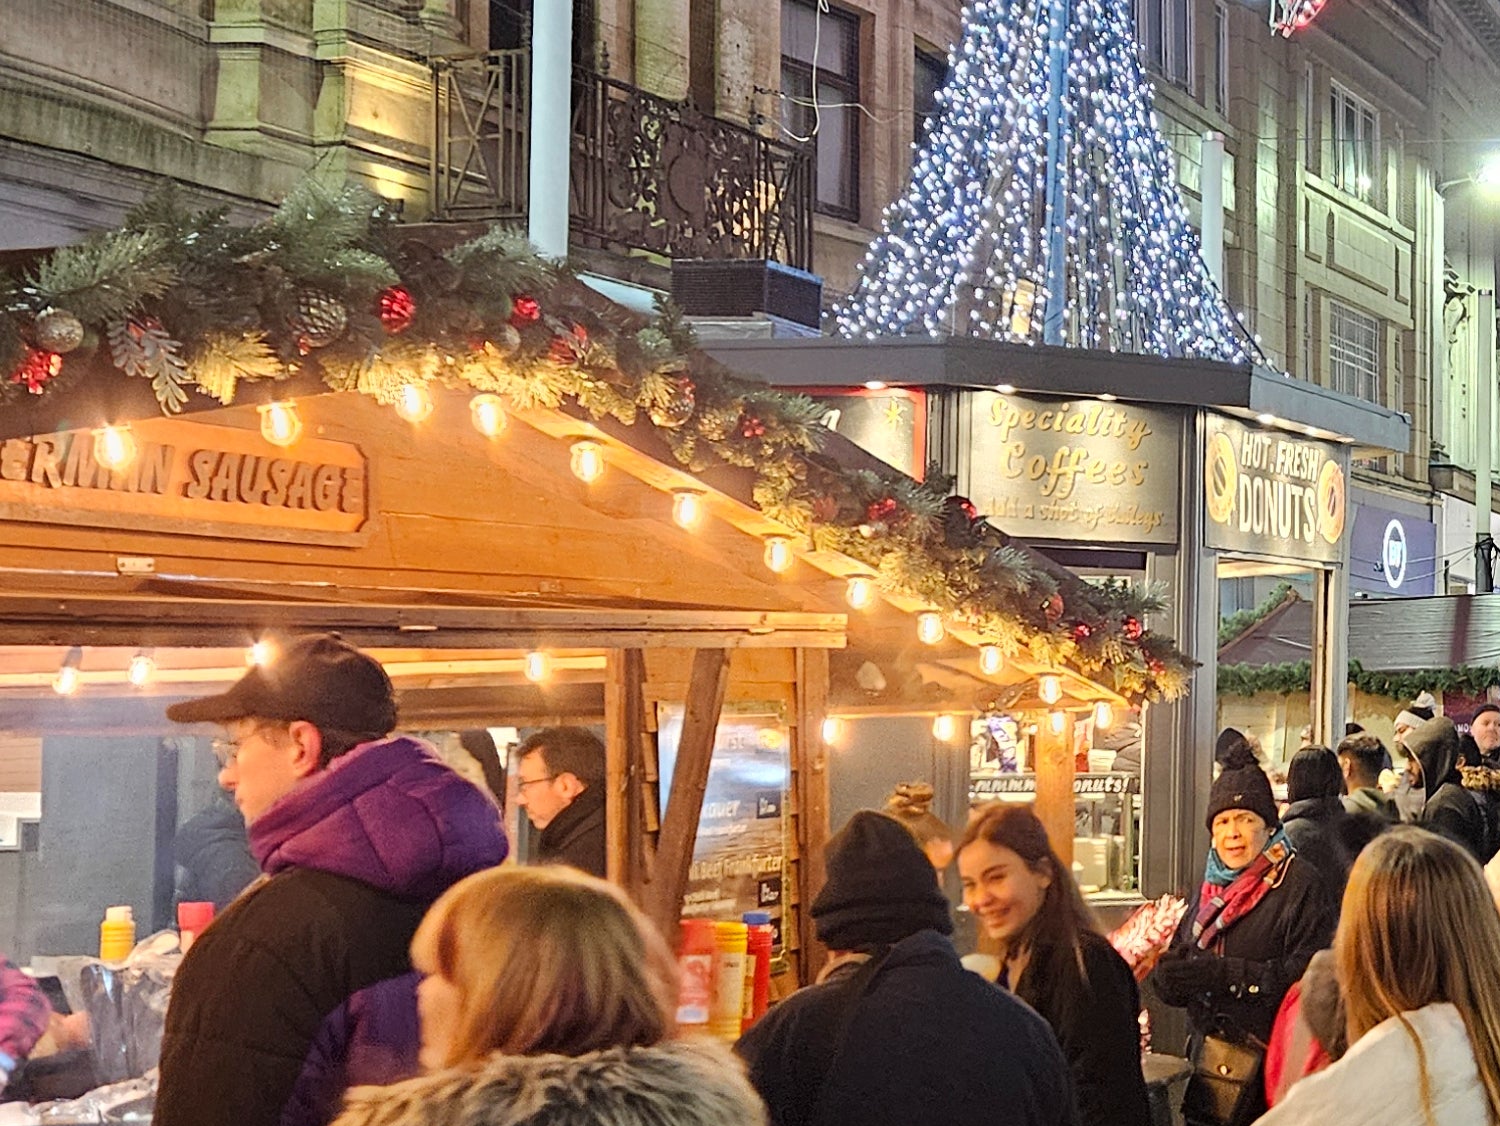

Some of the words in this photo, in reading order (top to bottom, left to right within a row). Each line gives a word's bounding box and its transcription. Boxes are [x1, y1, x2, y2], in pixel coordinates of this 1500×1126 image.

[988, 396, 1153, 450] Speciality
[182, 449, 366, 513] SAUSAGE
[1002, 446, 1150, 499] Coffees
[1275, 440, 1320, 482] FRESH
[1039, 501, 1080, 522] shot
[1081, 505, 1104, 532] of
[1239, 473, 1316, 543] DONUTS
